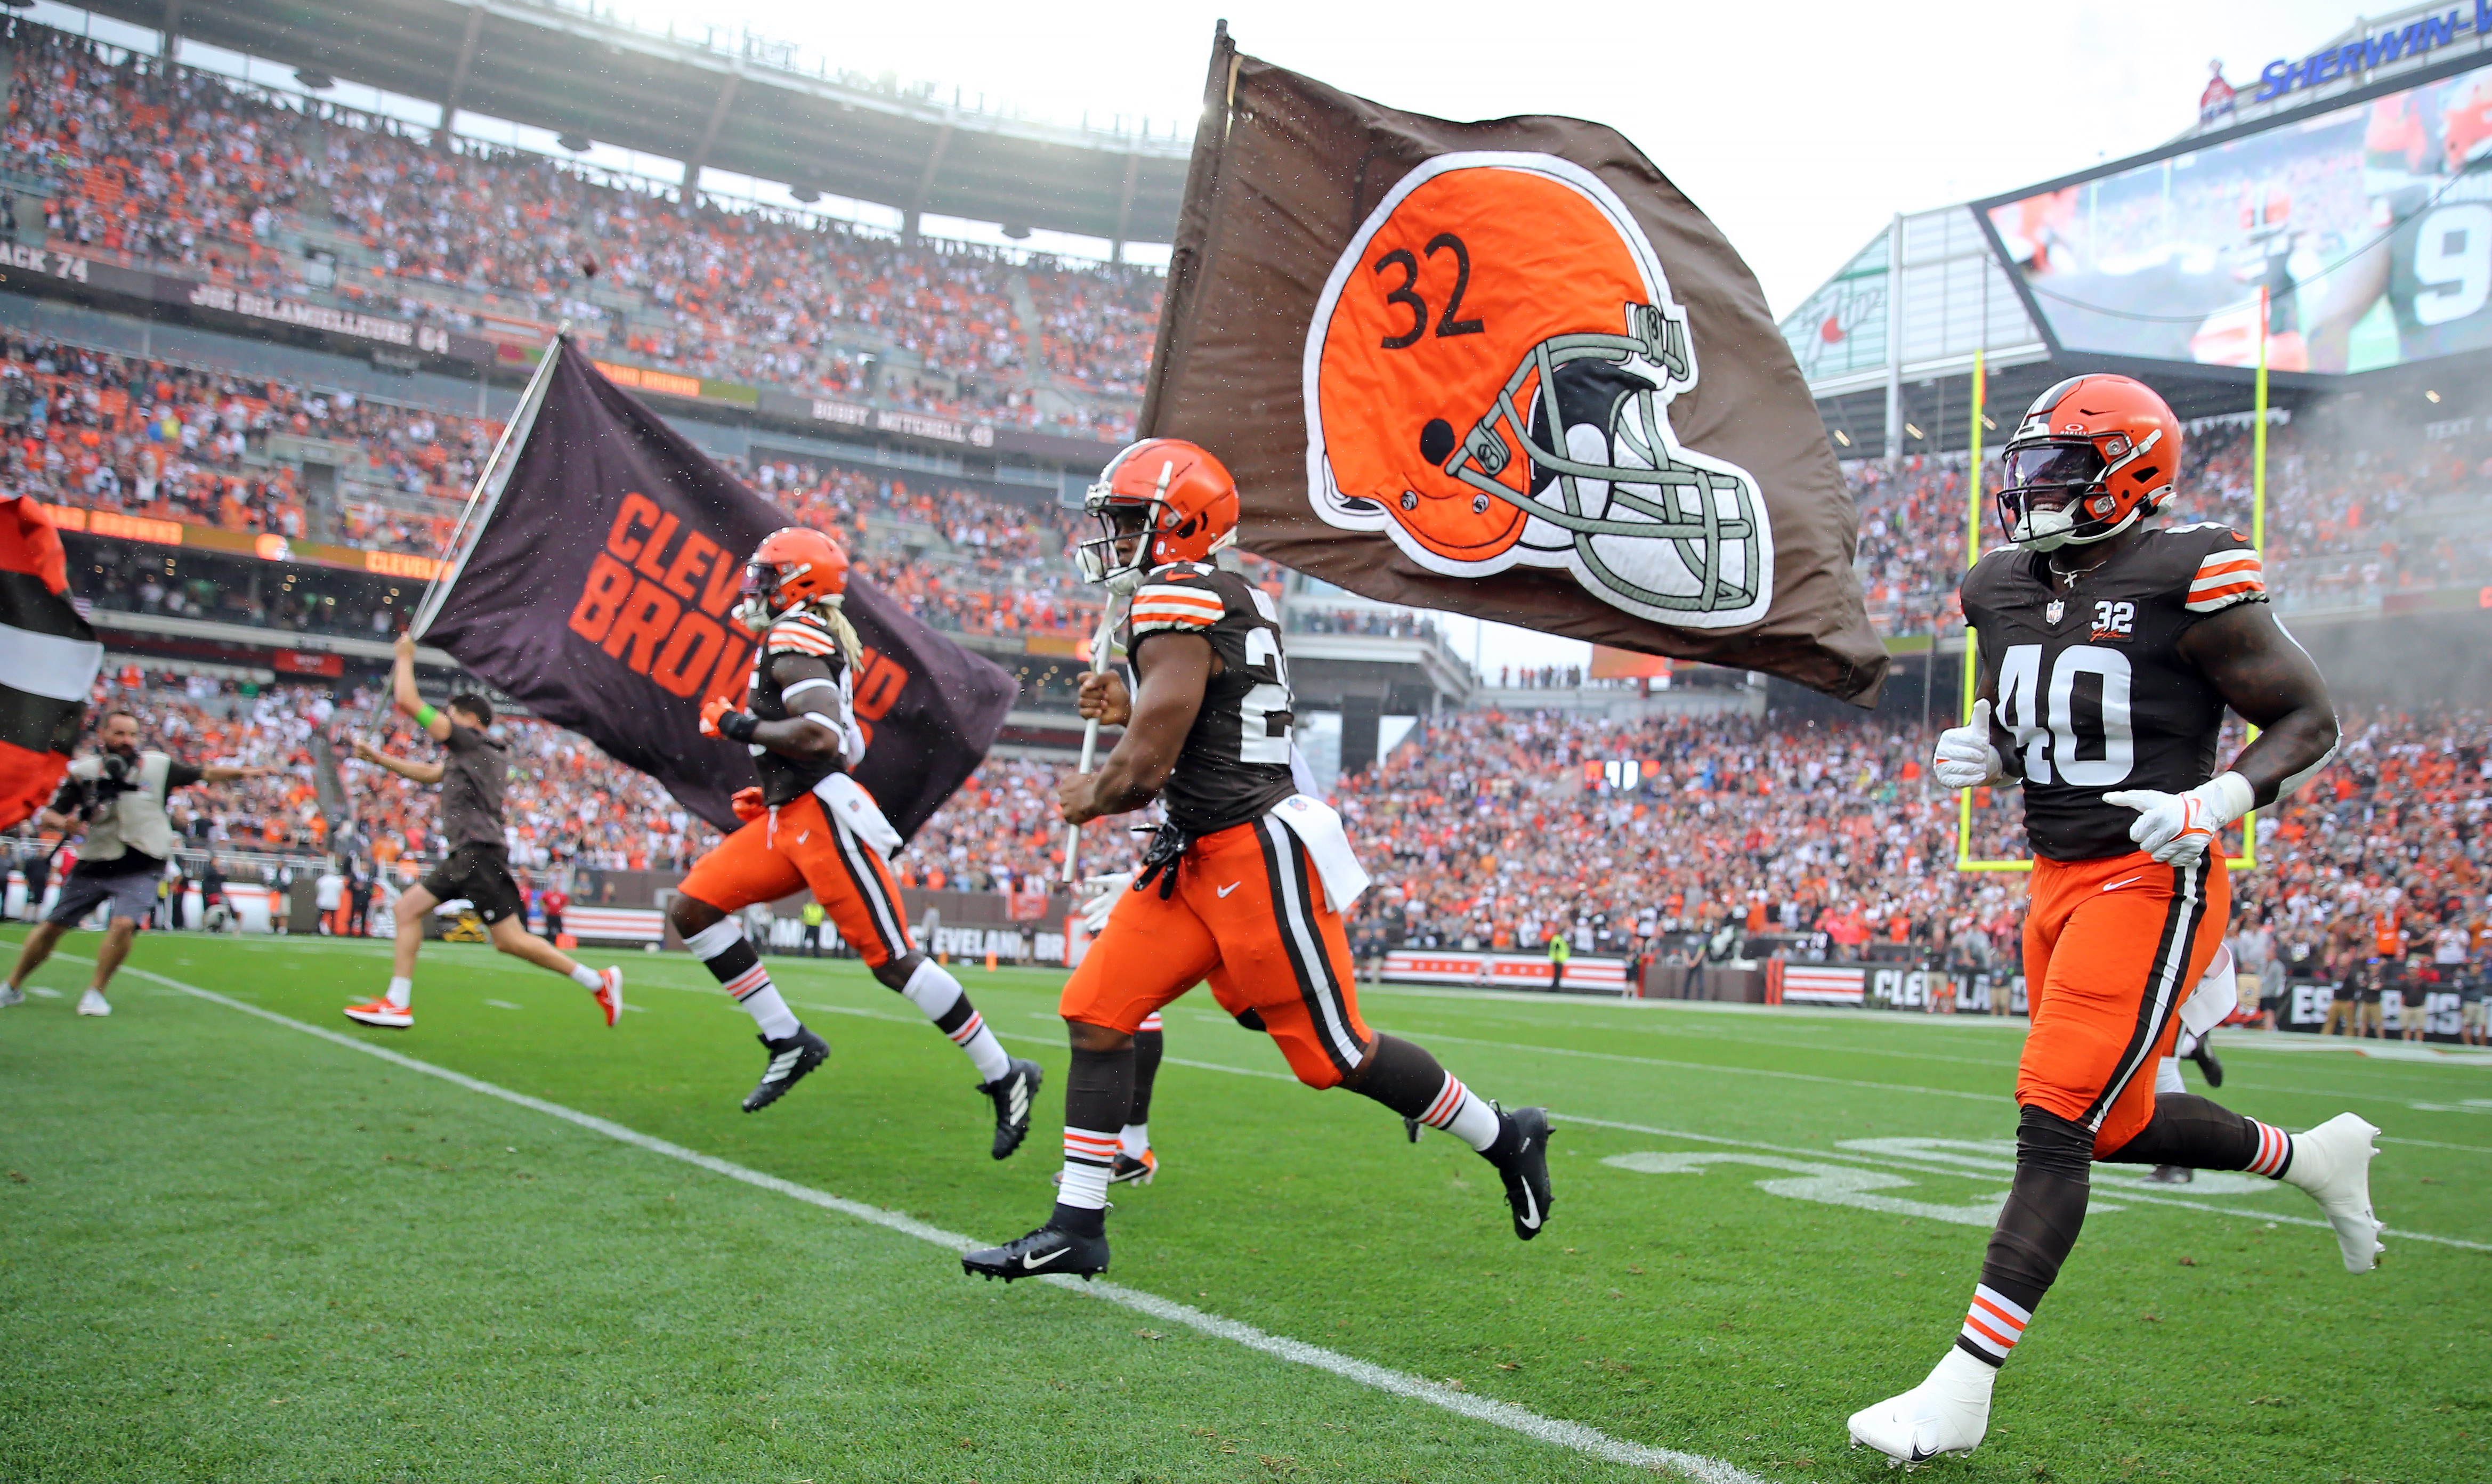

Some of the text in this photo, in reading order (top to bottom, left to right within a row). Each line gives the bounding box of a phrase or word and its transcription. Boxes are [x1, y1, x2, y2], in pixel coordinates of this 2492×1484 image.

[55, 252, 88, 283] 74
[189, 283, 236, 312] JOE
[1373, 233, 1485, 349] 32
[606, 492, 908, 721] CLEVD
[2091, 601, 2135, 633] 32
[1995, 644, 2134, 787] 40
